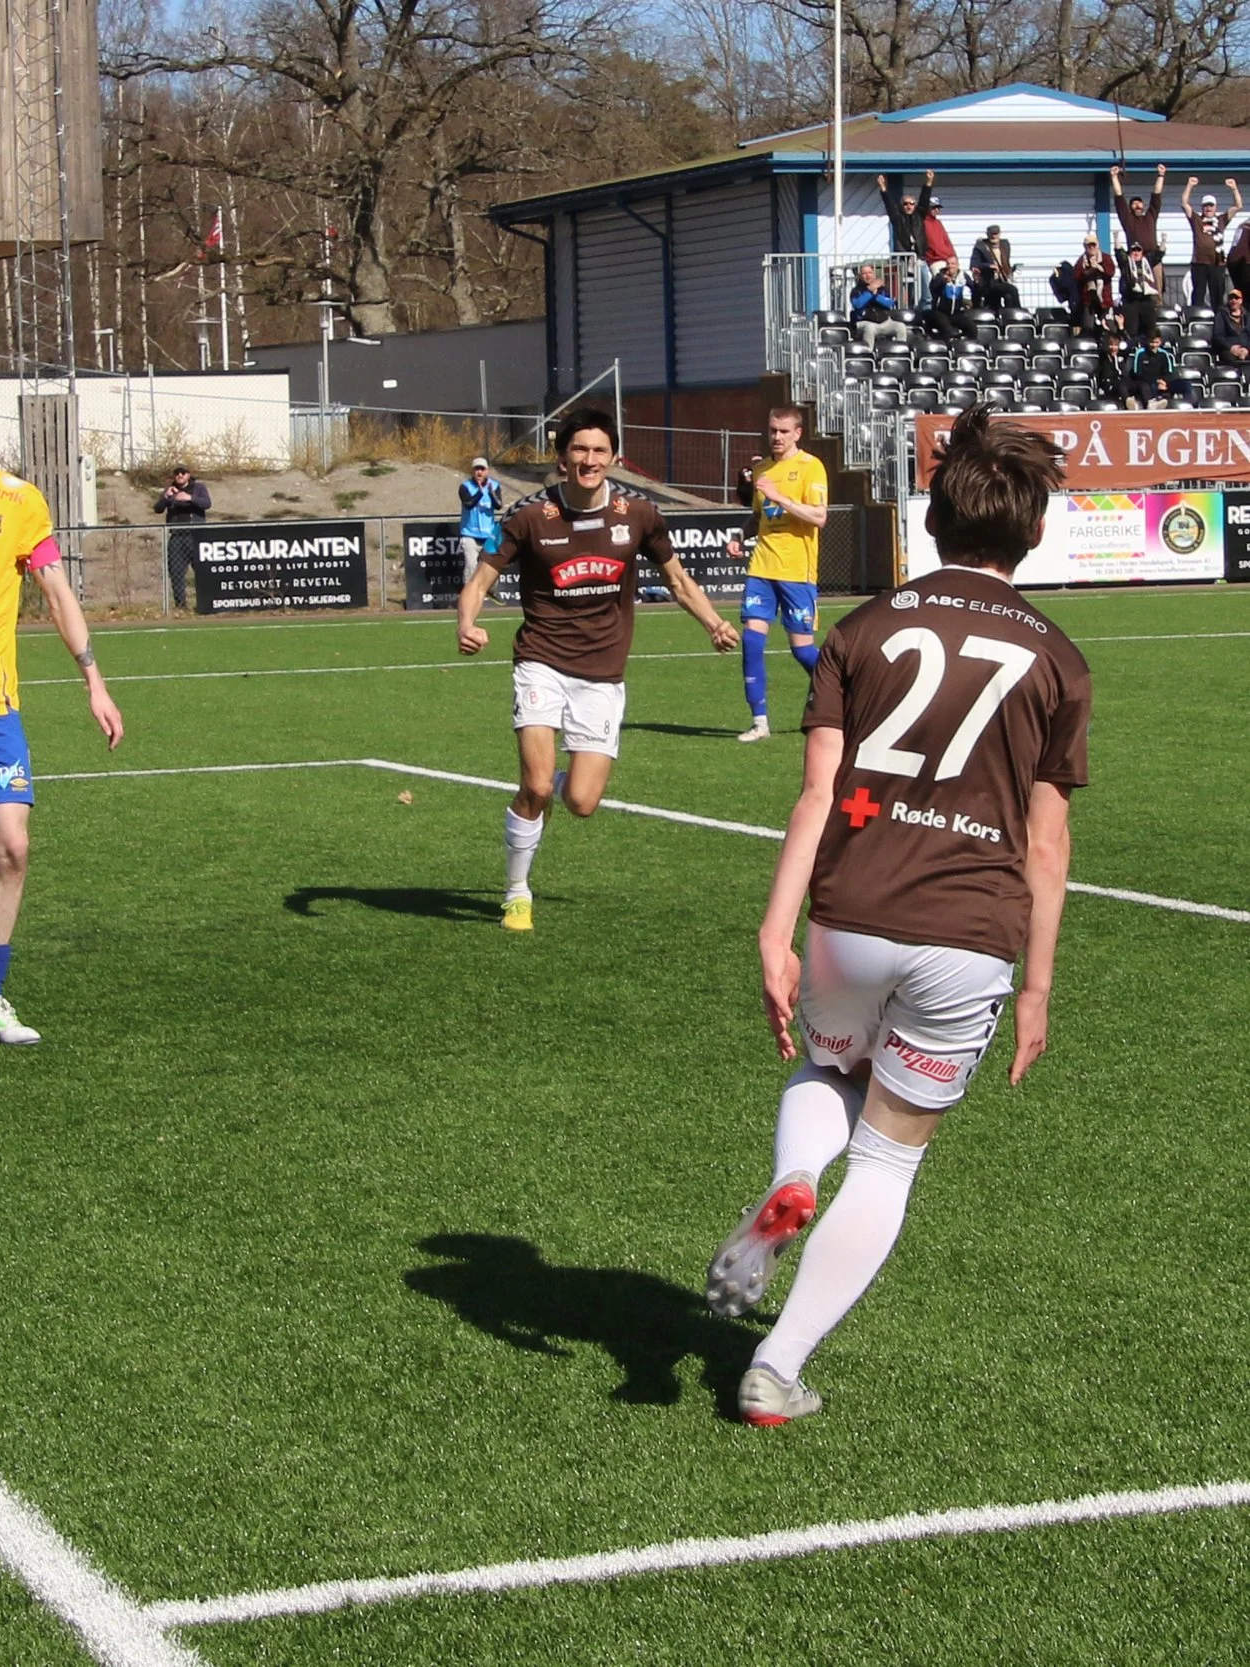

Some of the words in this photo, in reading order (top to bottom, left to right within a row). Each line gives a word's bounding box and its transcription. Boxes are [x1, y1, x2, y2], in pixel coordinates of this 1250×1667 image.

[1125, 427, 1250, 468] EGEN
[1069, 525, 1142, 537] FARGERIKE
[199, 536, 360, 562] RESTAURANTEN
[700, 551, 722, 559] LIVE
[211, 565, 239, 573] GOOD
[244, 564, 271, 572] FOOD
[286, 562, 309, 570] LIVE
[313, 560, 350, 569] SPORTS
[558, 561, 618, 580] MENY
[293, 577, 342, 588] REVETAL
[554, 584, 621, 597] BORREVEIEN
[212, 598, 261, 609] SPORTSPUB
[925, 594, 965, 609] ABC
[968, 600, 1048, 634] ELEKTRO
[854, 627, 1038, 782] 27
[604, 720, 610, 735] 8
[891, 800, 947, 830] Røde
[952, 812, 1002, 843] Kors
